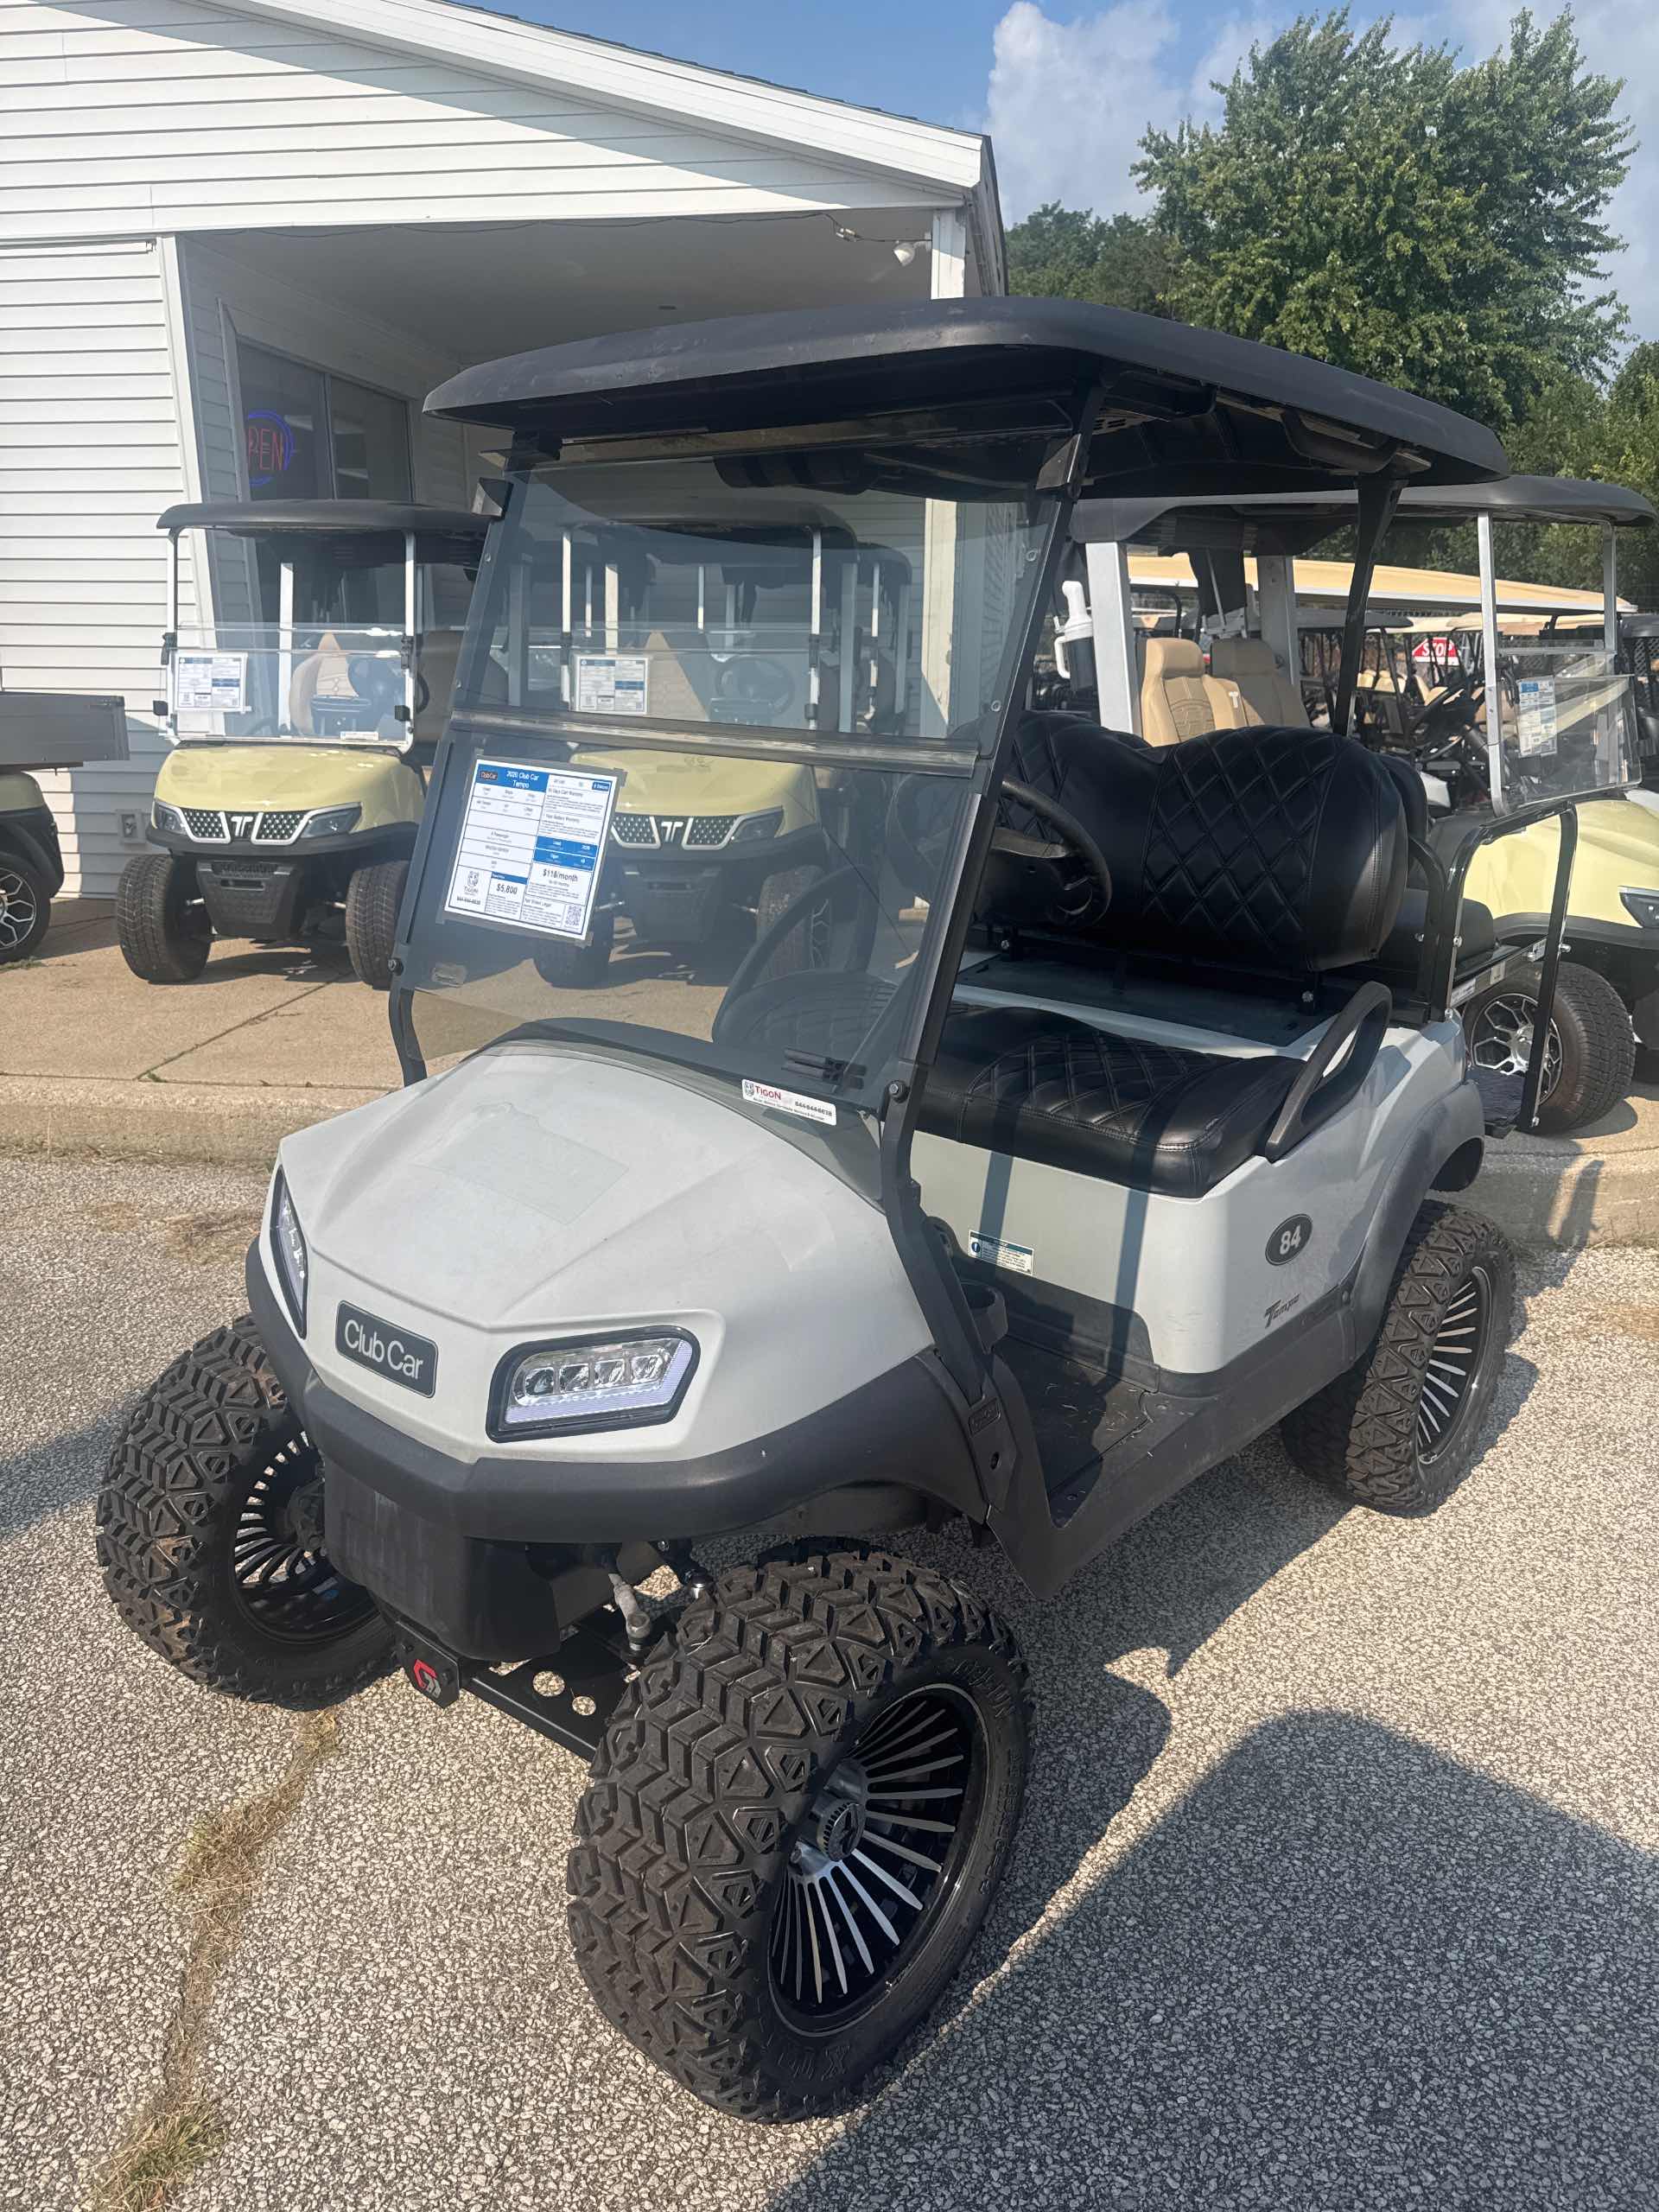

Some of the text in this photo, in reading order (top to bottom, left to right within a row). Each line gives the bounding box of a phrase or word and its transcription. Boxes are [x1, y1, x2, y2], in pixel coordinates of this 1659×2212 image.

[248, 427, 283, 471] PEN
[512, 779, 530, 789] Tempo
[755, 1085, 782, 1100] TIGON
[1280, 1224, 1301, 1255] 84
